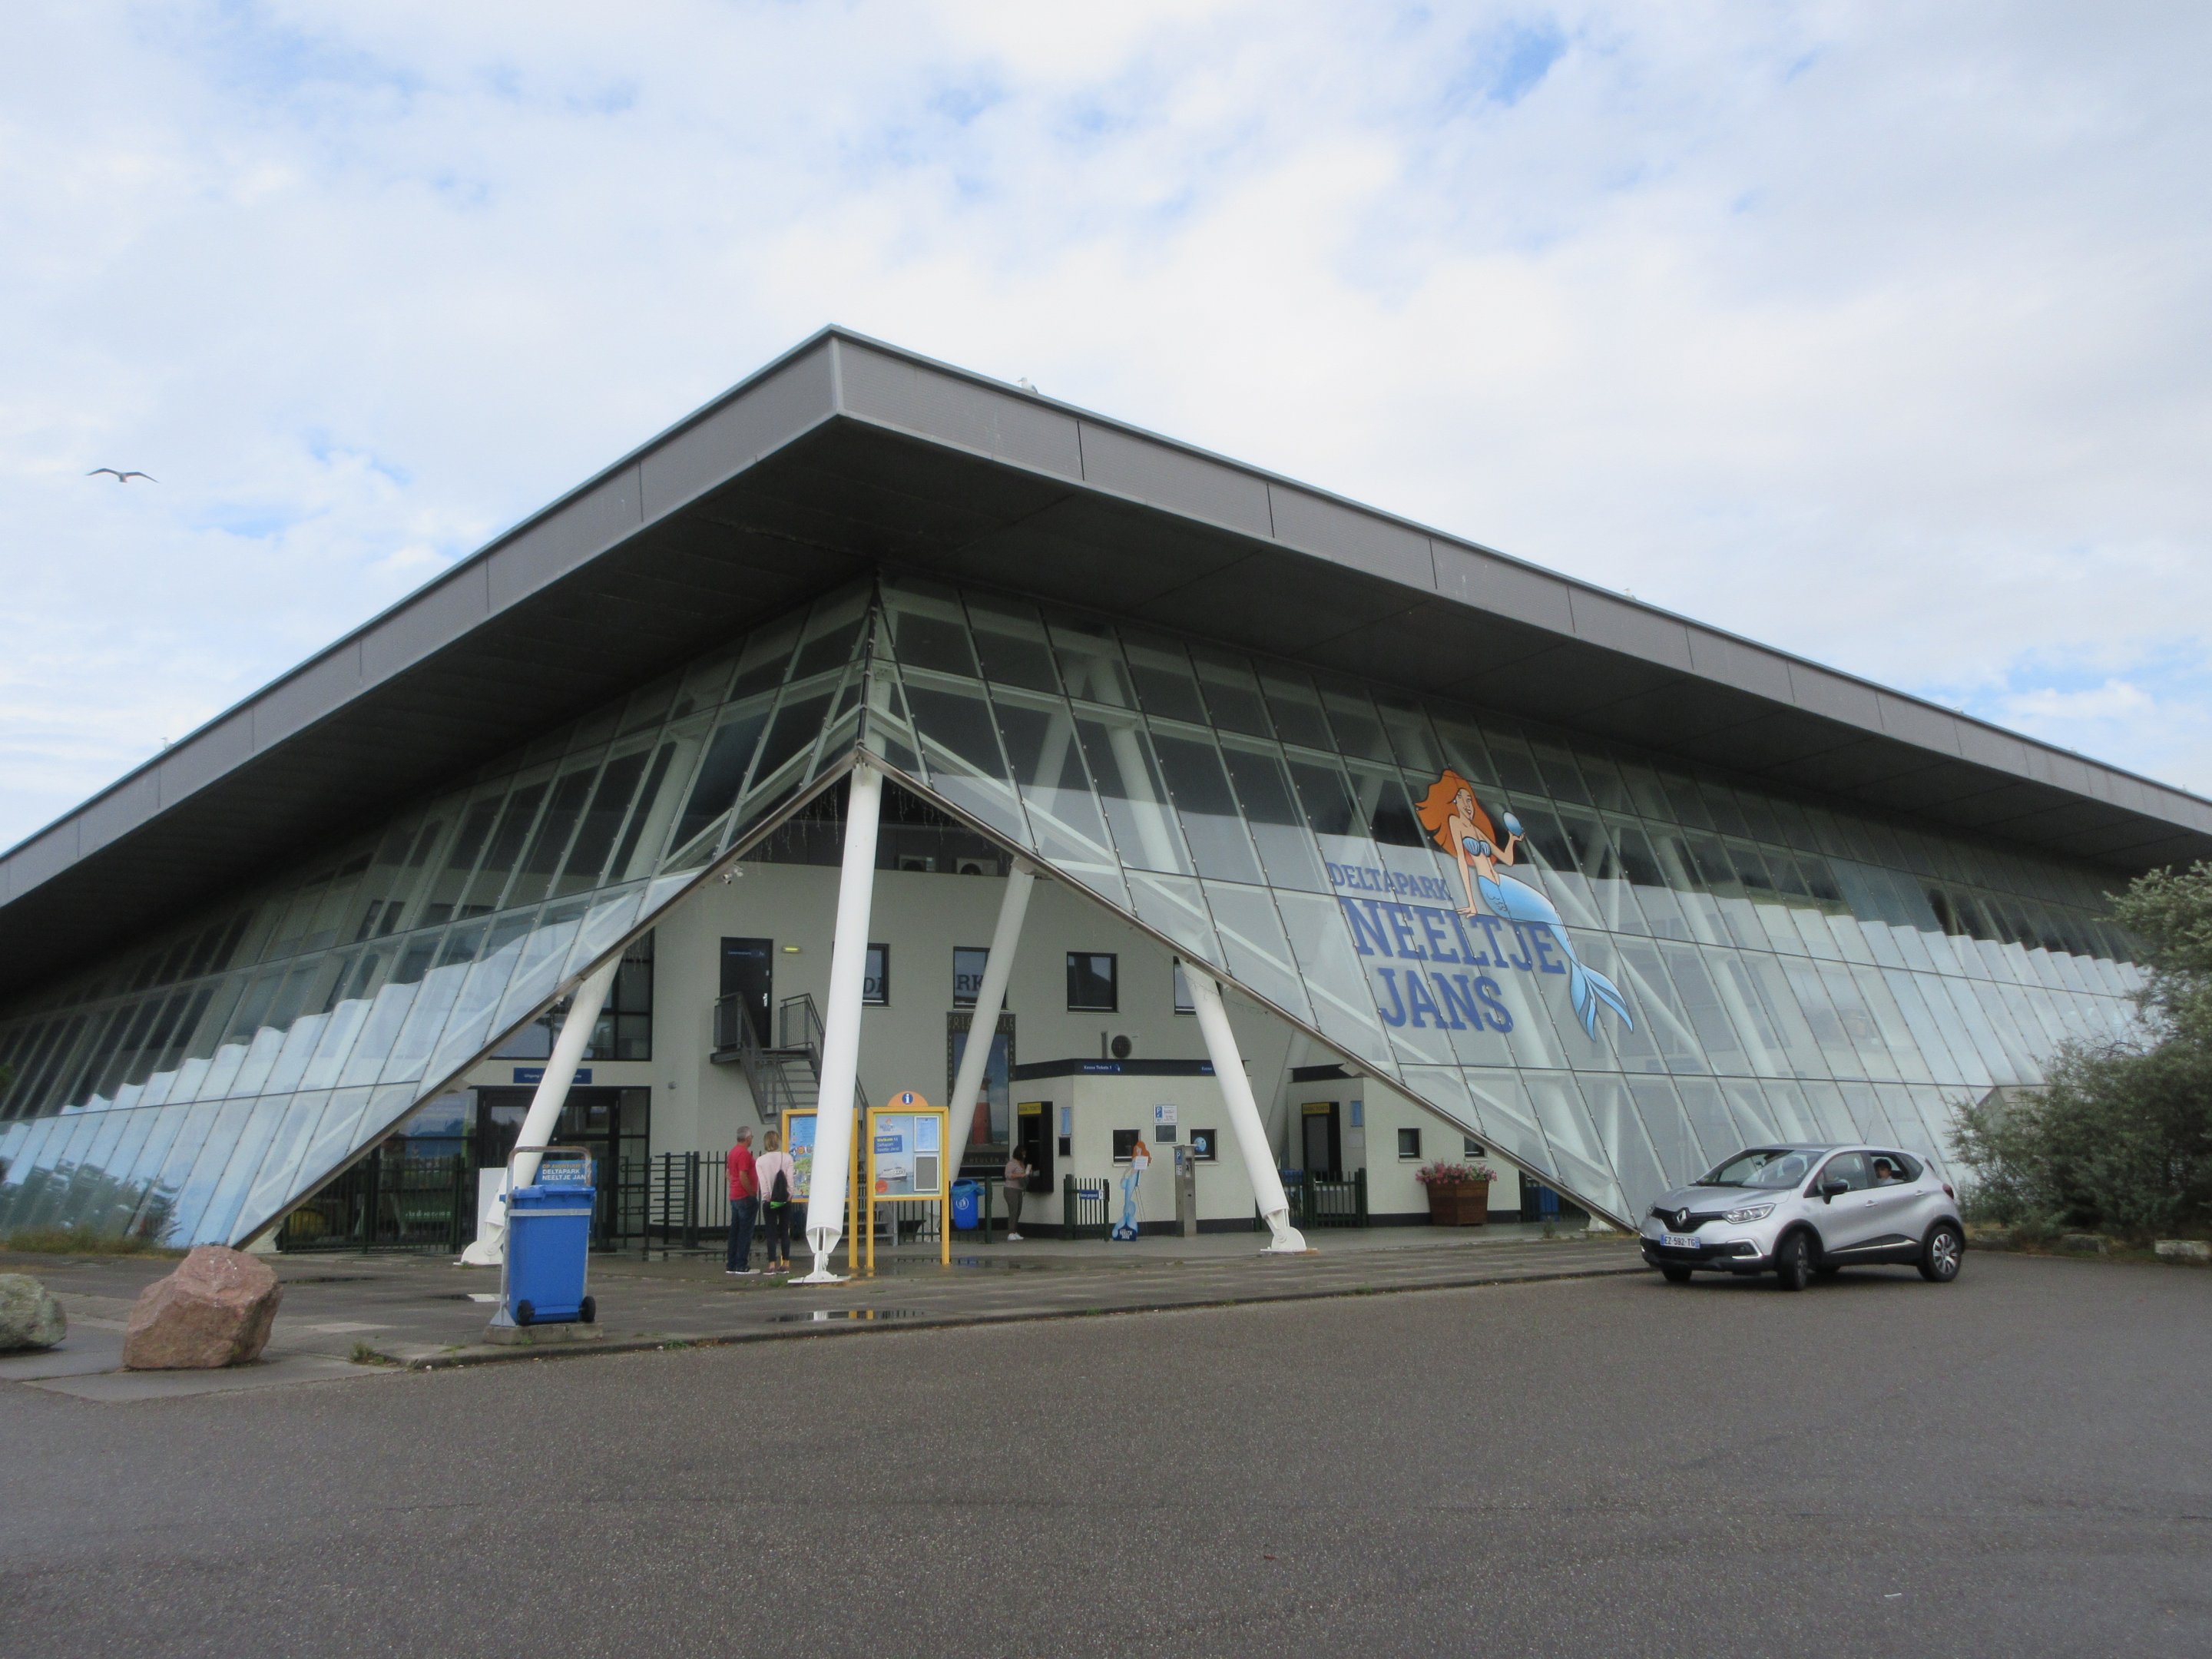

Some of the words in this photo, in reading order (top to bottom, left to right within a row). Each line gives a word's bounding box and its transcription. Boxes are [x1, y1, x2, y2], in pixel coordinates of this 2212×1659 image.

[1326, 862, 1452, 901] DELTAPARK
[1339, 896, 1567, 975] NEELTJE
[1378, 967, 1514, 1033] JANS
[1664, 1236, 1696, 1247] EZ-592-TG
